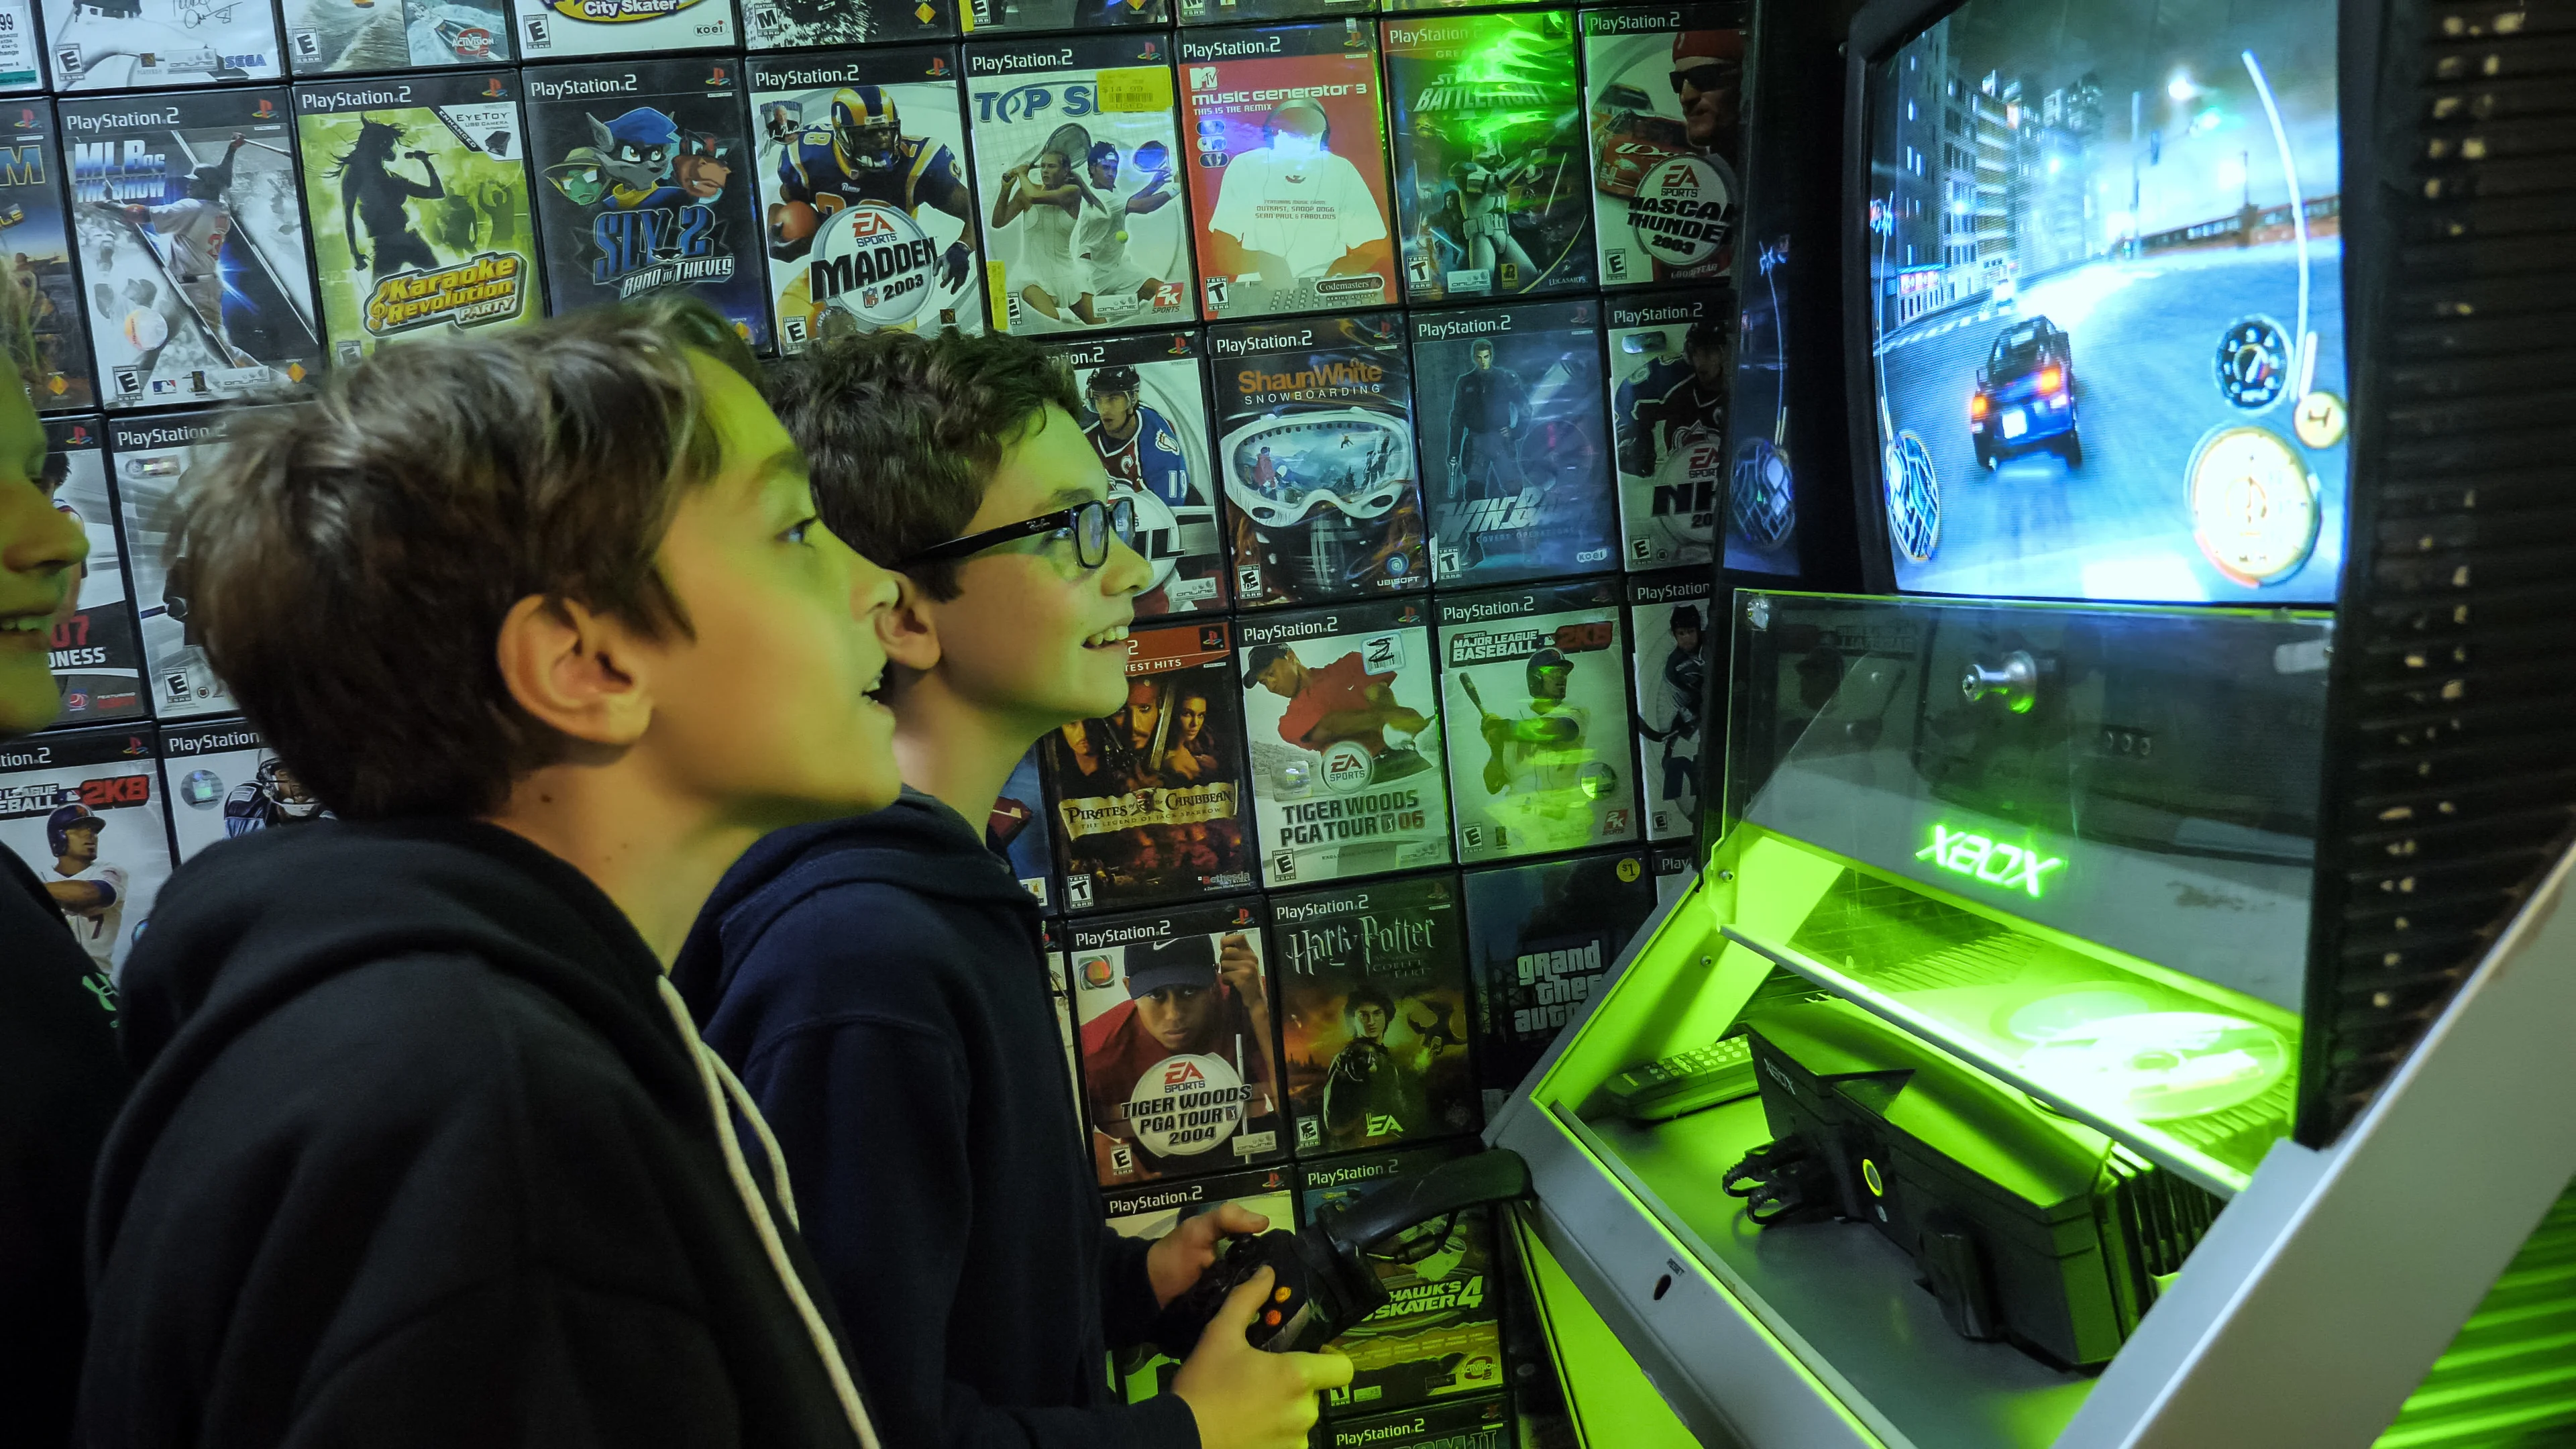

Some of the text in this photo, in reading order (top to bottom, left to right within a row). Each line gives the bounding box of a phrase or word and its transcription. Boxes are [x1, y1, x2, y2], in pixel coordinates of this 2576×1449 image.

[584, 0, 675, 15] City Skater
[757, 8, 777, 28] M
[528, 21, 546, 42] E
[1591, 12, 1680, 33] PlayStation 2
[297, 34, 315, 55] E
[452, 34, 494, 47] ACTIVISION
[1390, 28, 1468, 46] PlayStation
[1184, 37, 1281, 60] PlayStation 2
[60, 51, 80, 72] E
[225, 54, 266, 68] SEGA
[973, 49, 1073, 73] PlayStation 2
[531, 74, 637, 99] PlayStation 2
[756, 64, 859, 89] PlayStation 2
[303, 87, 411, 111] PlayStation 2
[1356, 84, 1366, 94] 3
[974, 86, 1053, 123] TOP
[67, 107, 180, 132] PlayStation 2
[439, 111, 476, 148] ENHANCED
[1662, 164, 1699, 187] EA
[1661, 189, 1697, 197] SPORTS
[852, 213, 896, 237] EA
[594, 206, 715, 284] SLY 2
[856, 233, 898, 247] SPORTS
[1652, 235, 1696, 255] 2003
[811, 237, 938, 302] MADDEN
[1410, 262, 1426, 280] T
[1609, 255, 1623, 273] E
[389, 258, 517, 303] Karaoke
[622, 258, 732, 299] BAND OF THIEVES
[883, 274, 924, 301] 2003
[1319, 281, 1369, 291] Codemasters
[388, 280, 515, 325] Revolution
[1158, 285, 1180, 305] 2K
[1209, 283, 1224, 302] T
[460, 298, 515, 321] PARTY
[1151, 306, 1180, 314] SPORTS
[1615, 303, 1703, 325] PlayStation 2
[787, 323, 806, 342] E
[1419, 315, 1511, 339] PlayStation 2
[1218, 331, 1312, 355] PlayStation 2
[1093, 347, 1105, 362] 2
[118, 373, 139, 393] E
[1245, 384, 1380, 405] SNOWBOARDING
[117, 426, 209, 448] PlayStation
[1633, 541, 1649, 558] E
[1442, 554, 1455, 572] T
[1377, 576, 1419, 586] UBISOFT
[1638, 582, 1709, 602] PlayStation
[1444, 596, 1534, 622] PlayStation 2
[1244, 616, 1338, 643] PlayStation 2
[1454, 631, 1538, 648] MAJOR LEAGUE
[1128, 640, 1138, 655] 2
[1453, 641, 1536, 661] BASEBALL
[1155, 659, 1181, 669] HITS
[168, 675, 188, 694] E
[169, 732, 259, 754] PlayStation
[37, 747, 52, 763] 2
[1331, 753, 1363, 773] EA
[1330, 770, 1365, 782] SPORTS
[83, 777, 147, 804] 2K8
[1103, 818, 1136, 827] LEGEND
[1181, 807, 1221, 816] SPARROW
[1282, 789, 1419, 824] TIGER WOODS
[1281, 810, 1425, 847] PGA TOUR 06
[1607, 811, 1625, 828] 2K
[1655, 814, 1666, 828] E
[1465, 828, 1481, 847] E
[1277, 855, 1293, 873] E
[1622, 863, 1636, 877] $1
[1915, 825, 2061, 898] XBOX
[1203, 871, 1250, 885] Bethesda
[1071, 881, 1087, 900] T
[1277, 894, 1368, 920] PlayStation 2
[1076, 920, 1171, 947] PlayStation 2
[1358, 916, 1435, 976] Potter
[1517, 940, 1601, 985] grand
[1165, 1061, 1205, 1084] EA
[1764, 1058, 1796, 1095] XBOX
[1165, 1081, 1205, 1093] SPORTS
[1121, 1084, 1252, 1120] TIGER WOODS
[1140, 1108, 1222, 1135] PGA TOUR
[1366, 1113, 1403, 1136] EA
[1169, 1126, 1216, 1146] 2004
[1114, 1150, 1130, 1167] E
[1308, 1159, 1399, 1186] PlayStation 2
[1110, 1185, 1203, 1214] PlayStation 2
[1375, 1276, 1483, 1320] SKATER 4
[1390, 1281, 1461, 1302] HAWK'S
[1460, 1362, 1497, 1373] ACTIVISION
[1336, 1424, 1409, 1446] PlayStation
[1415, 1418, 1425, 1432] 2
